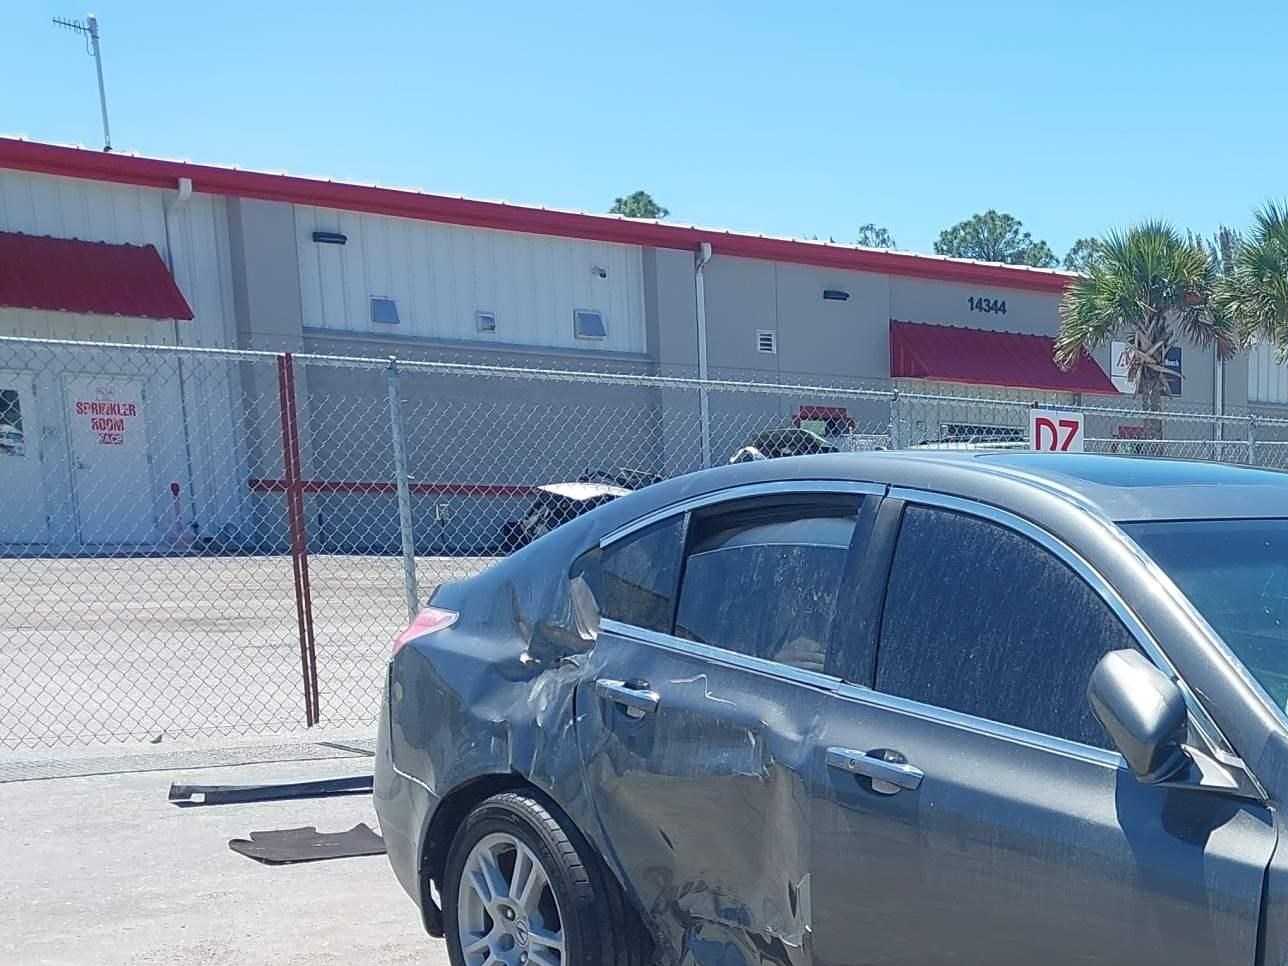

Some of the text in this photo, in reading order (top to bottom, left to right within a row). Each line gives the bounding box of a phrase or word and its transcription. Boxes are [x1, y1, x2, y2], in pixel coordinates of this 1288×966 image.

[967, 296, 1008, 315] 14344
[75, 401, 137, 417] SPRINKLER
[91, 417, 125, 432] ROOM
[1035, 417, 1079, 452] D7
